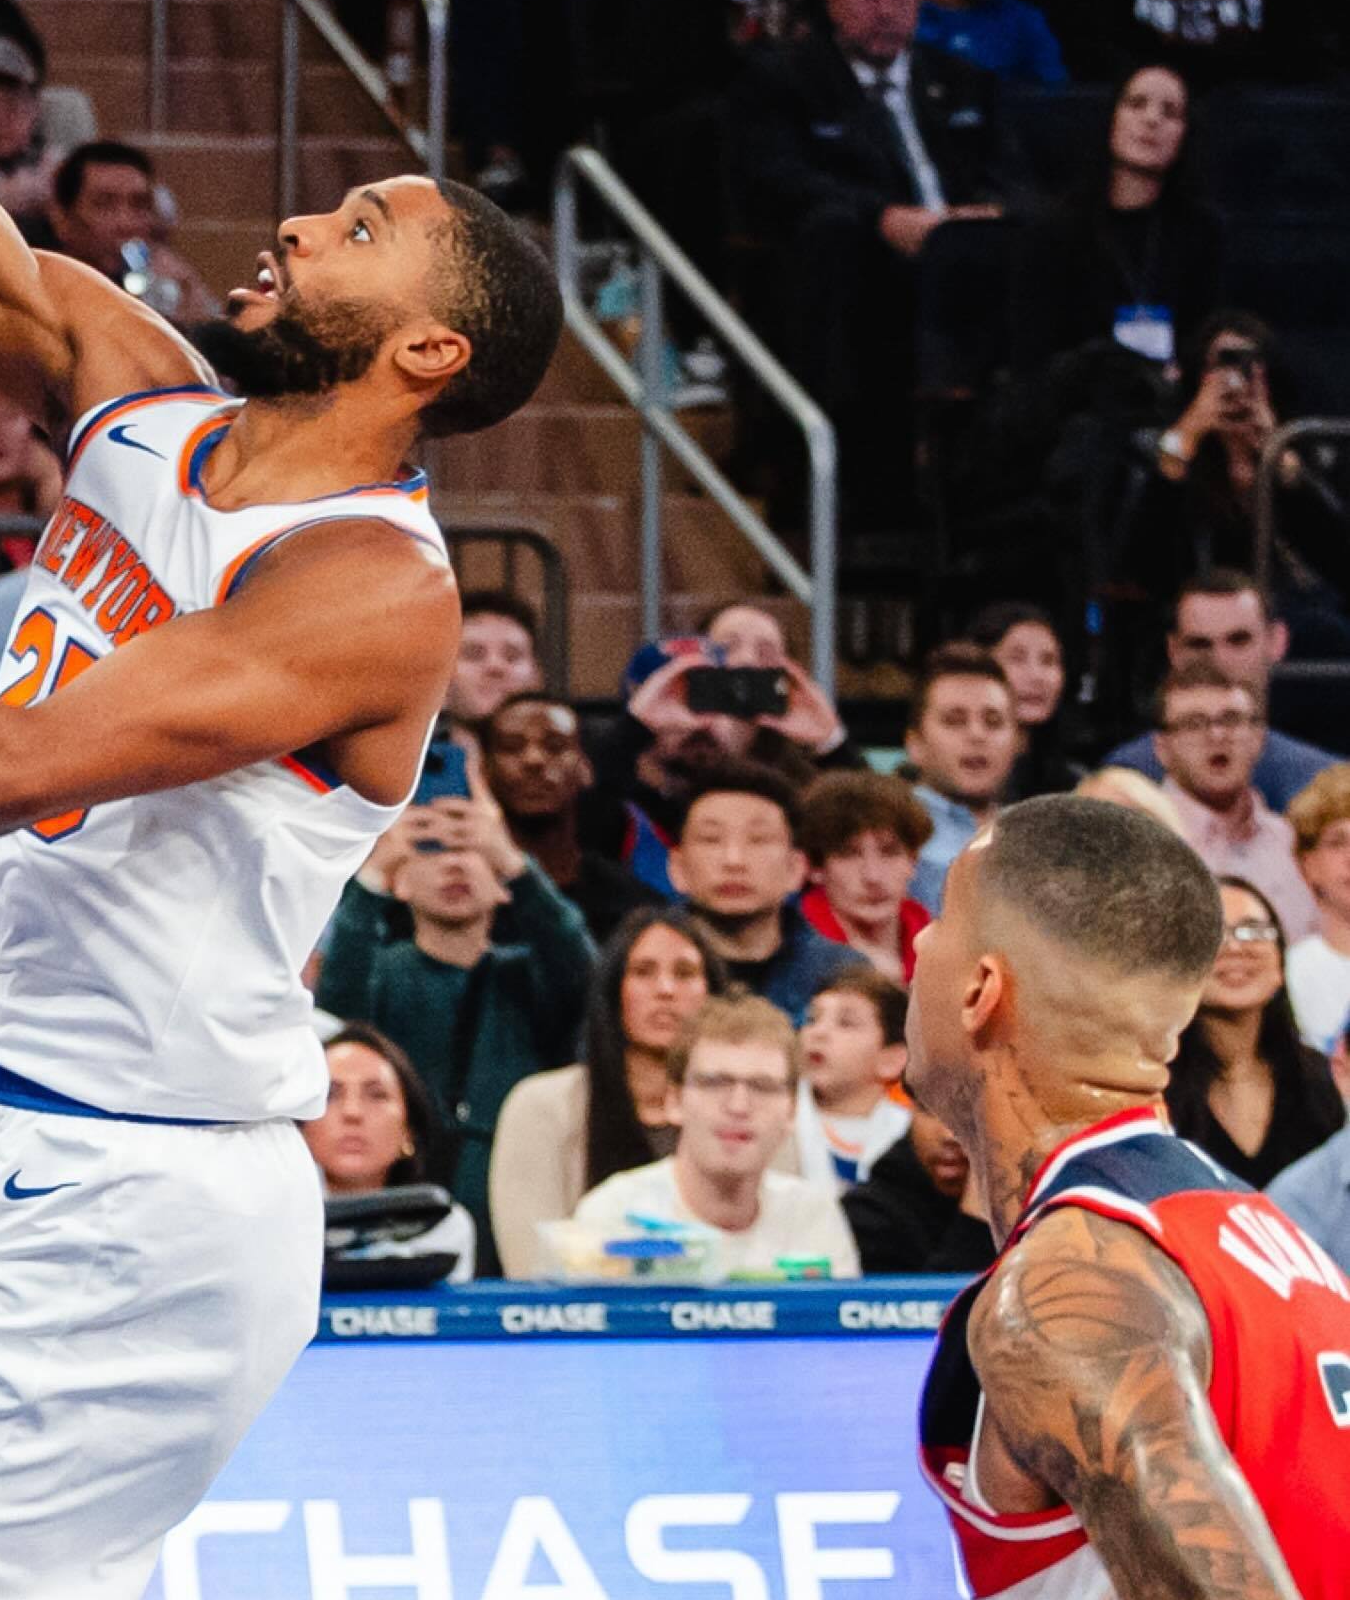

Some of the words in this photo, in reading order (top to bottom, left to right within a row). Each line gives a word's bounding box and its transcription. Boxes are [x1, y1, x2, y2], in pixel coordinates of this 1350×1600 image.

[80, 536, 184, 647] YOR
[330, 1306, 438, 1336] CHASE
[501, 1304, 607, 1334] CHASE
[670, 1302, 777, 1330] CHASE
[838, 1301, 947, 1329] CHASE
